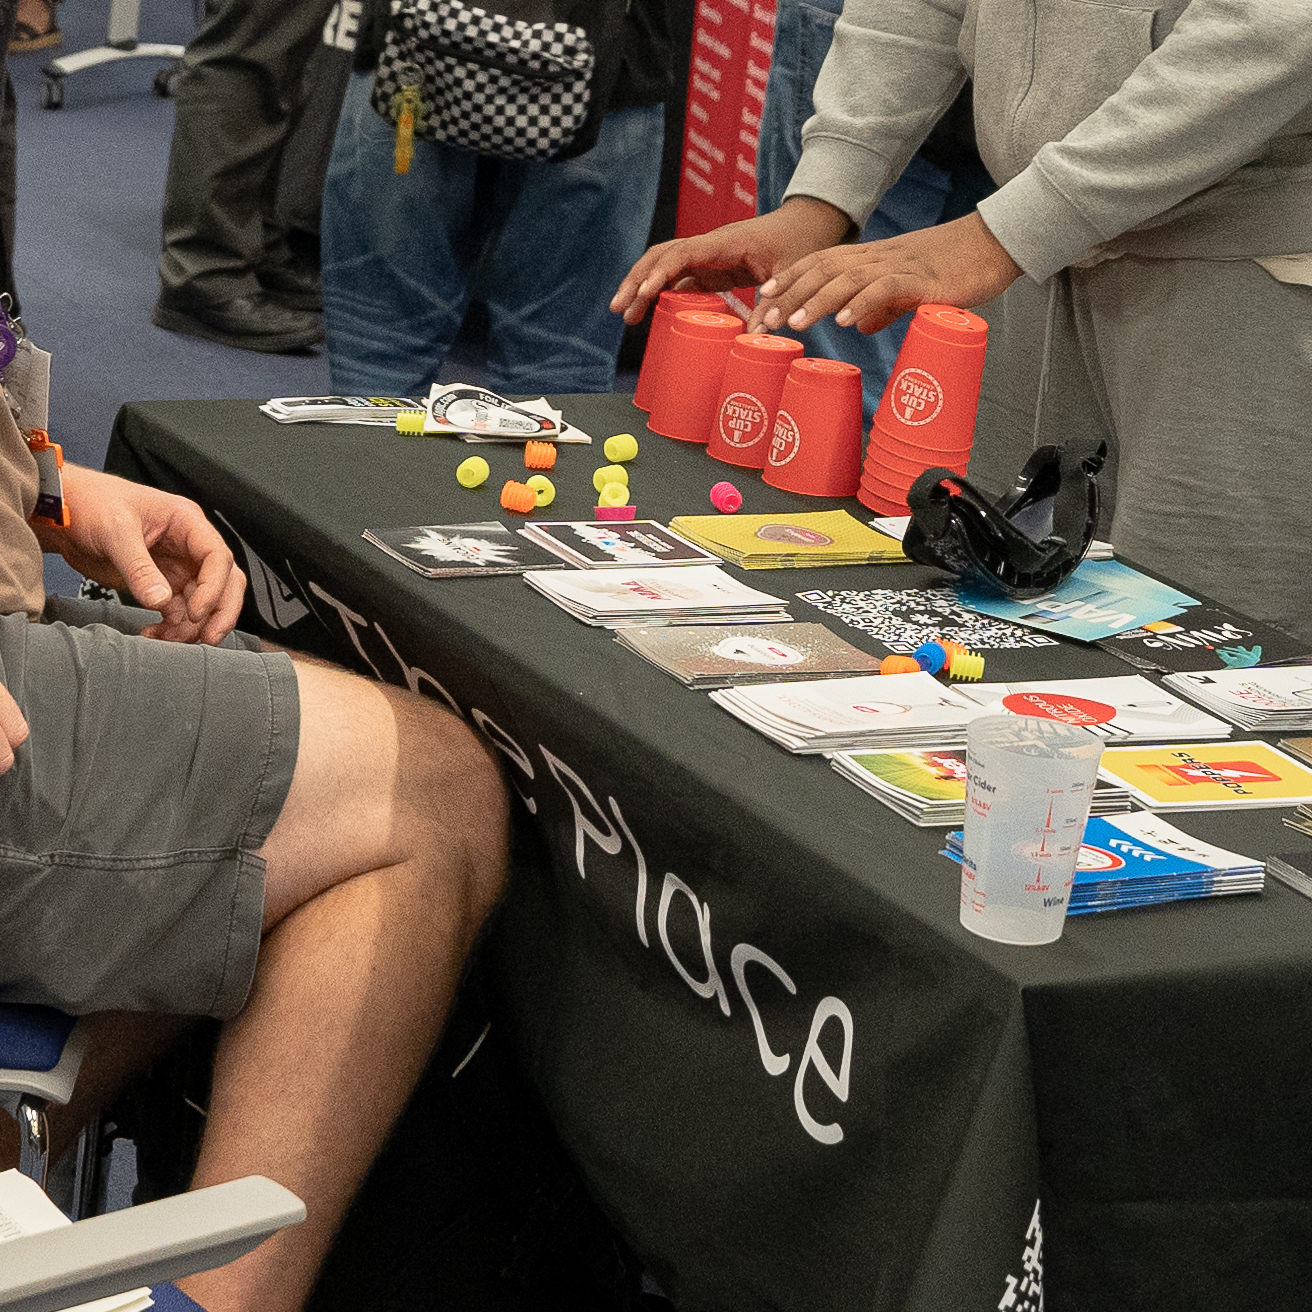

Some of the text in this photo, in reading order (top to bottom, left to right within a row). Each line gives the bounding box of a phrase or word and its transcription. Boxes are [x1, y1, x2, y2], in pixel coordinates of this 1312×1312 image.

[478, 392, 500, 407] FOIL
[899, 379, 937, 403] STACK
[900, 394, 926, 411] CUP
[725, 403, 761, 424] STACK
[728, 419, 752, 432] CUP
[1143, 622, 1254, 651] SPIKING
[1023, 693, 1082, 725] NITROUS
[1057, 703, 1098, 723] OXIDE
[1173, 750, 1253, 795] POPPERS
[973, 774, 997, 794] Cider
[308, 581, 855, 1145] The Place
[1043, 896, 1065, 908] Wine
